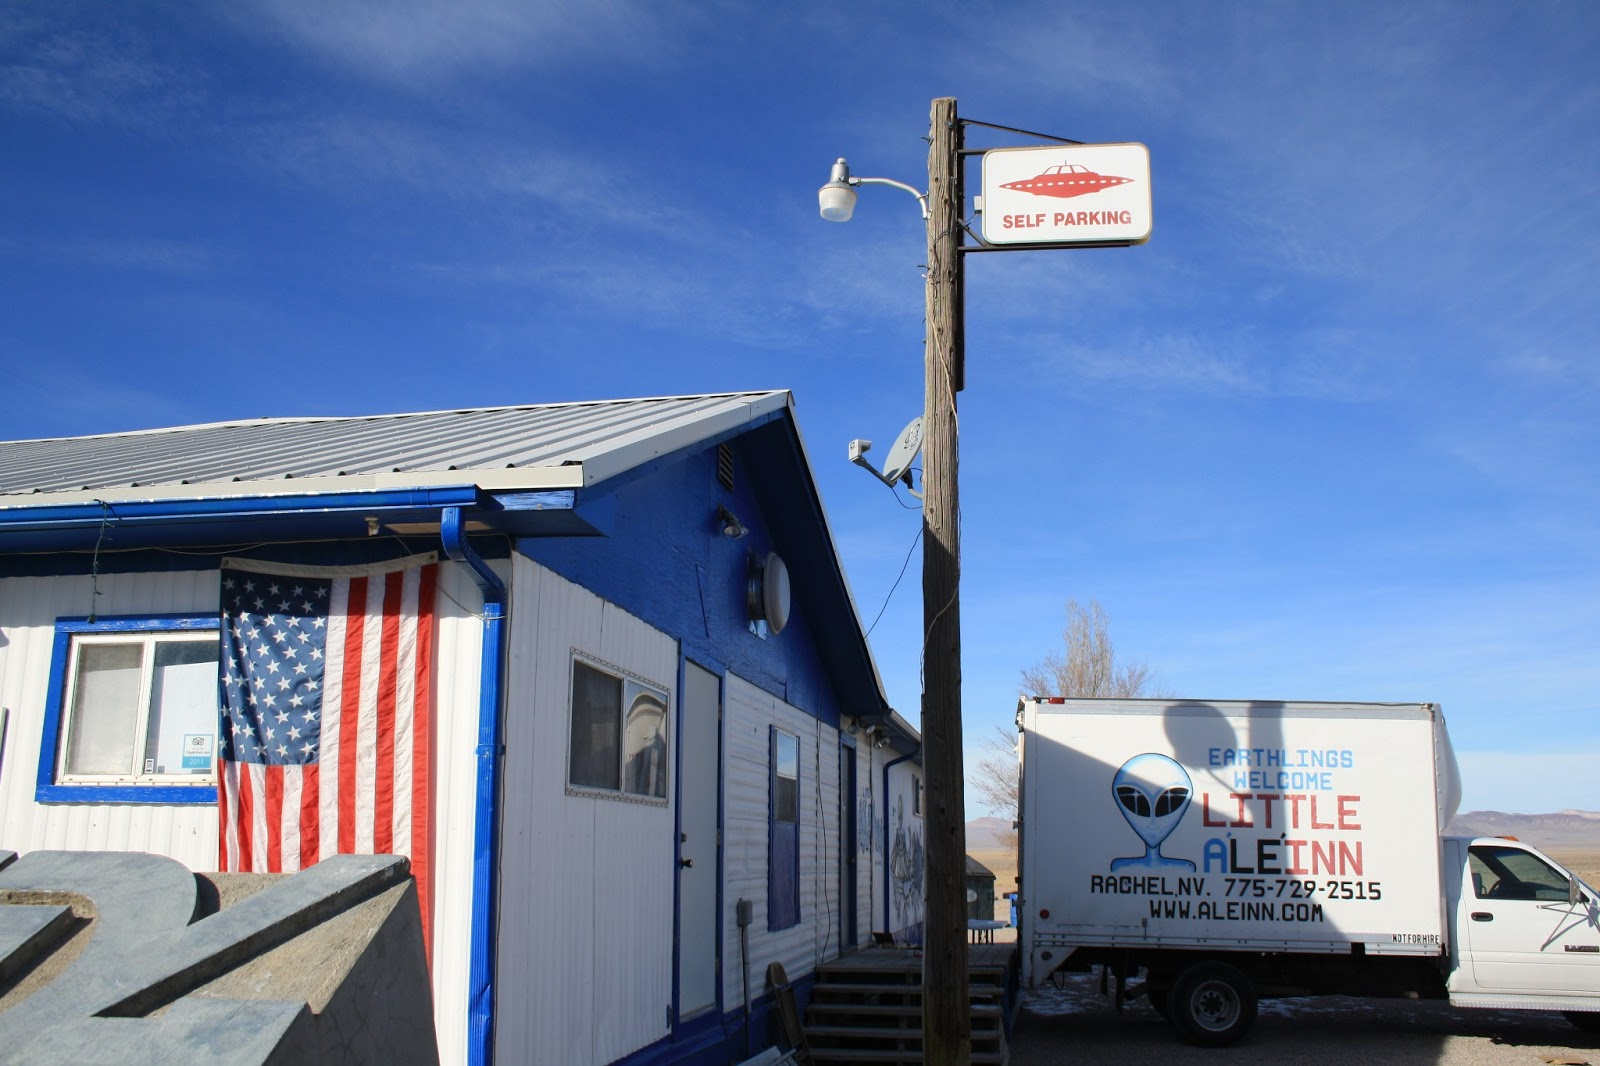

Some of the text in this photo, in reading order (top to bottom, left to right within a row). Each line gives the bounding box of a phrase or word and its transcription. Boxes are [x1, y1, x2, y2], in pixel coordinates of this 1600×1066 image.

[1003, 211, 1131, 229] SELF PARKING
[1208, 748, 1353, 768] EARTHLINGS
[1234, 771, 1333, 790] WELCOME
[1203, 792, 1361, 830] LITTLE
[1224, 878, 1381, 900] 775-729-2515
[1149, 900, 1323, 922] WWW.ALEINN.COM
